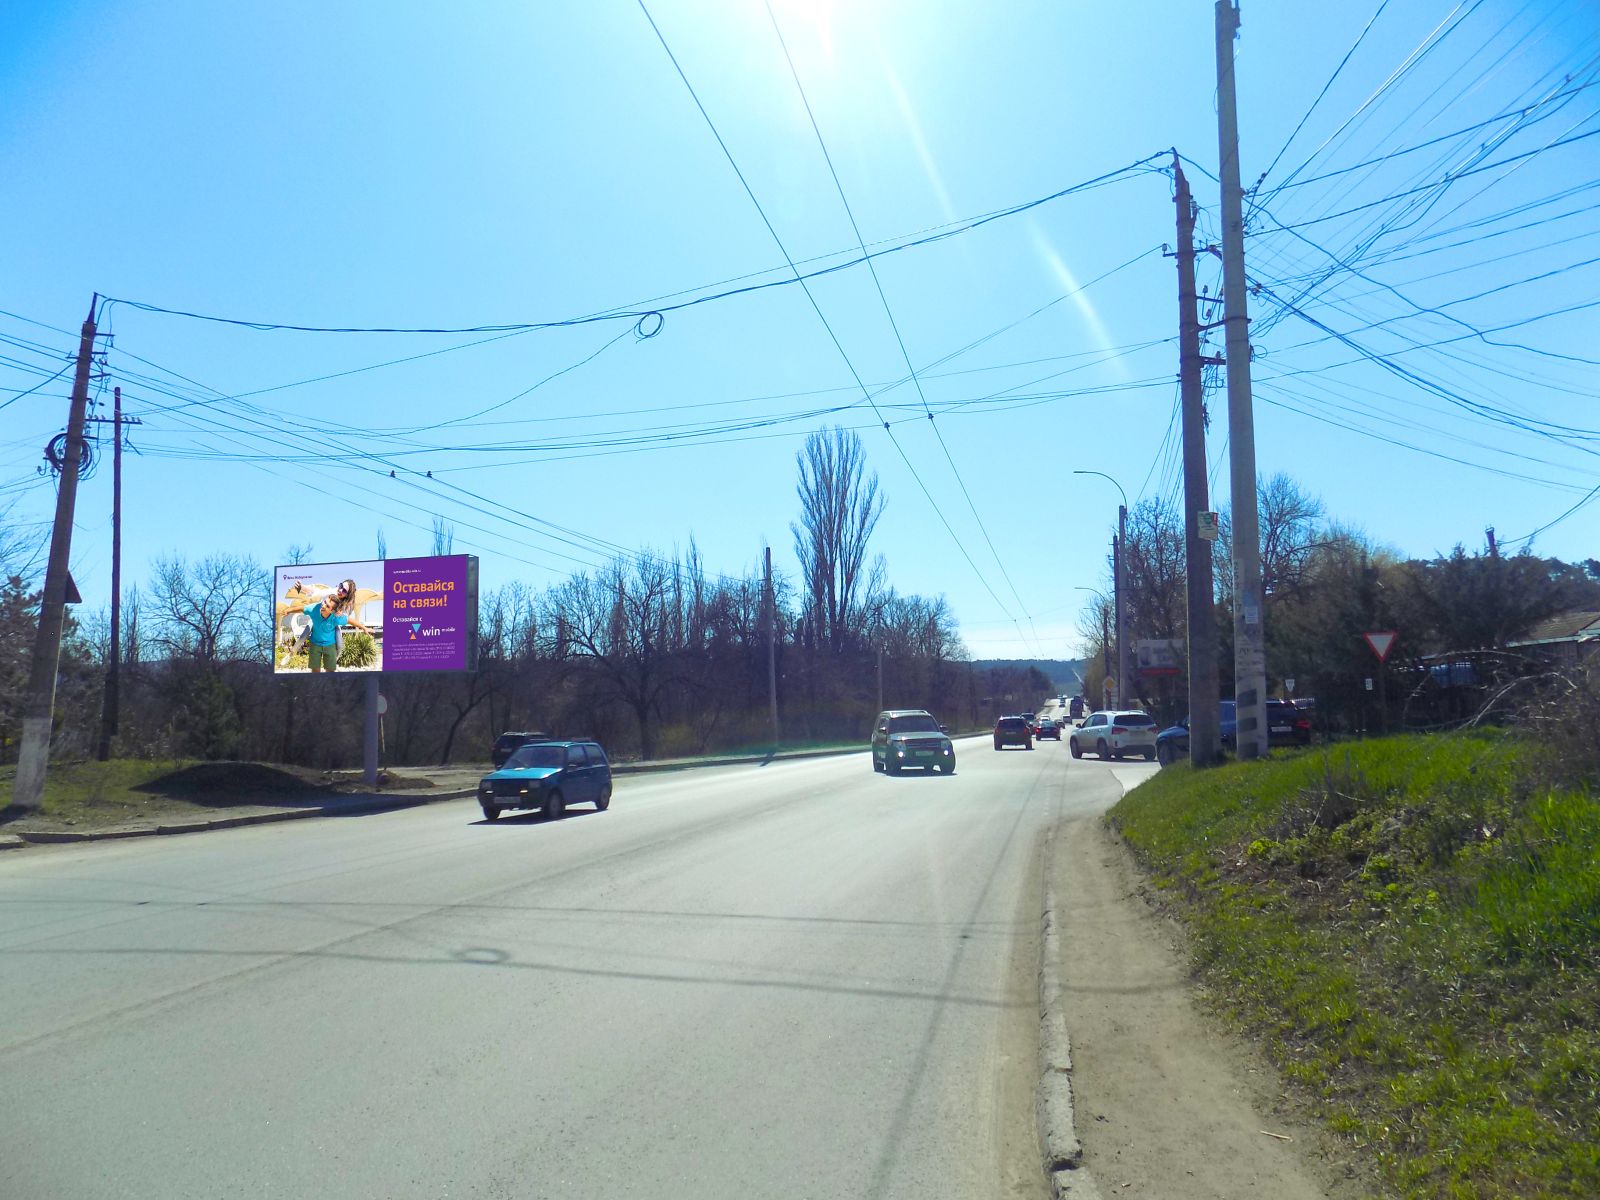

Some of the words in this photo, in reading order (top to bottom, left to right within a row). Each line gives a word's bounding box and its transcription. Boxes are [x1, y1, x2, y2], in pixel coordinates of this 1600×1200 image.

[393, 579, 455, 594] Оставайся
[393, 599, 407, 609] на
[410, 594, 448, 608] связи!
[422, 626, 441, 637] win
